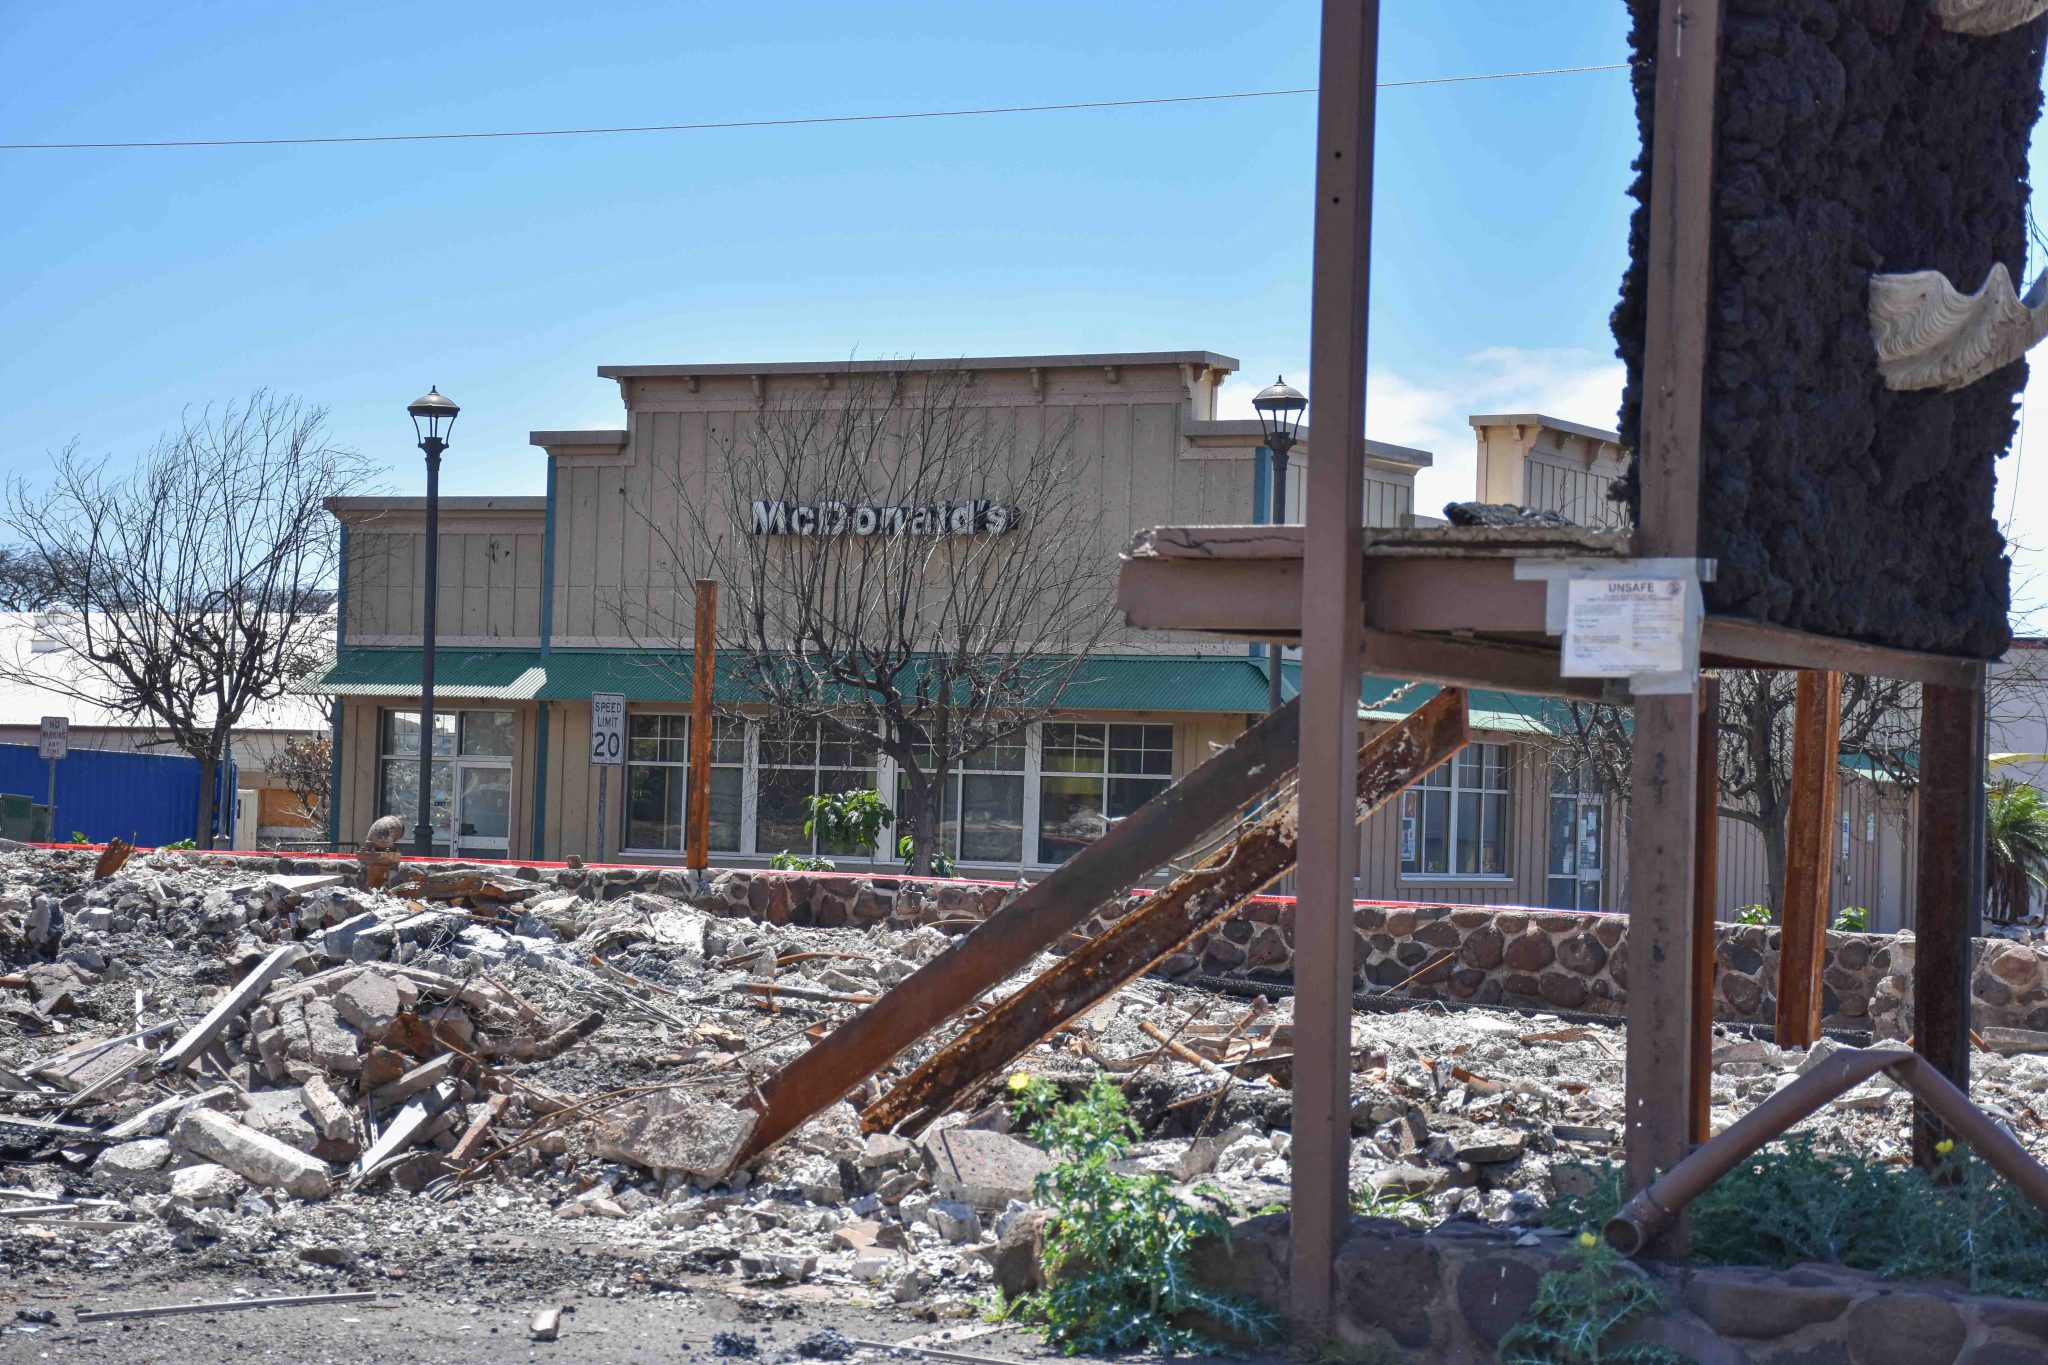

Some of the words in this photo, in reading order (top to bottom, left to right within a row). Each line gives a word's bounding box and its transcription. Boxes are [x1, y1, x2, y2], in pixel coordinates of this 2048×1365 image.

[752, 500, 1008, 535] McDonald's
[1608, 583, 1654, 592] UNSAFE
[595, 702, 621, 713] SPEED
[49, 720, 60, 729] NO
[597, 716, 618, 728] LIMIT
[42, 731, 66, 739] PARKING
[593, 732, 619, 757] 20
